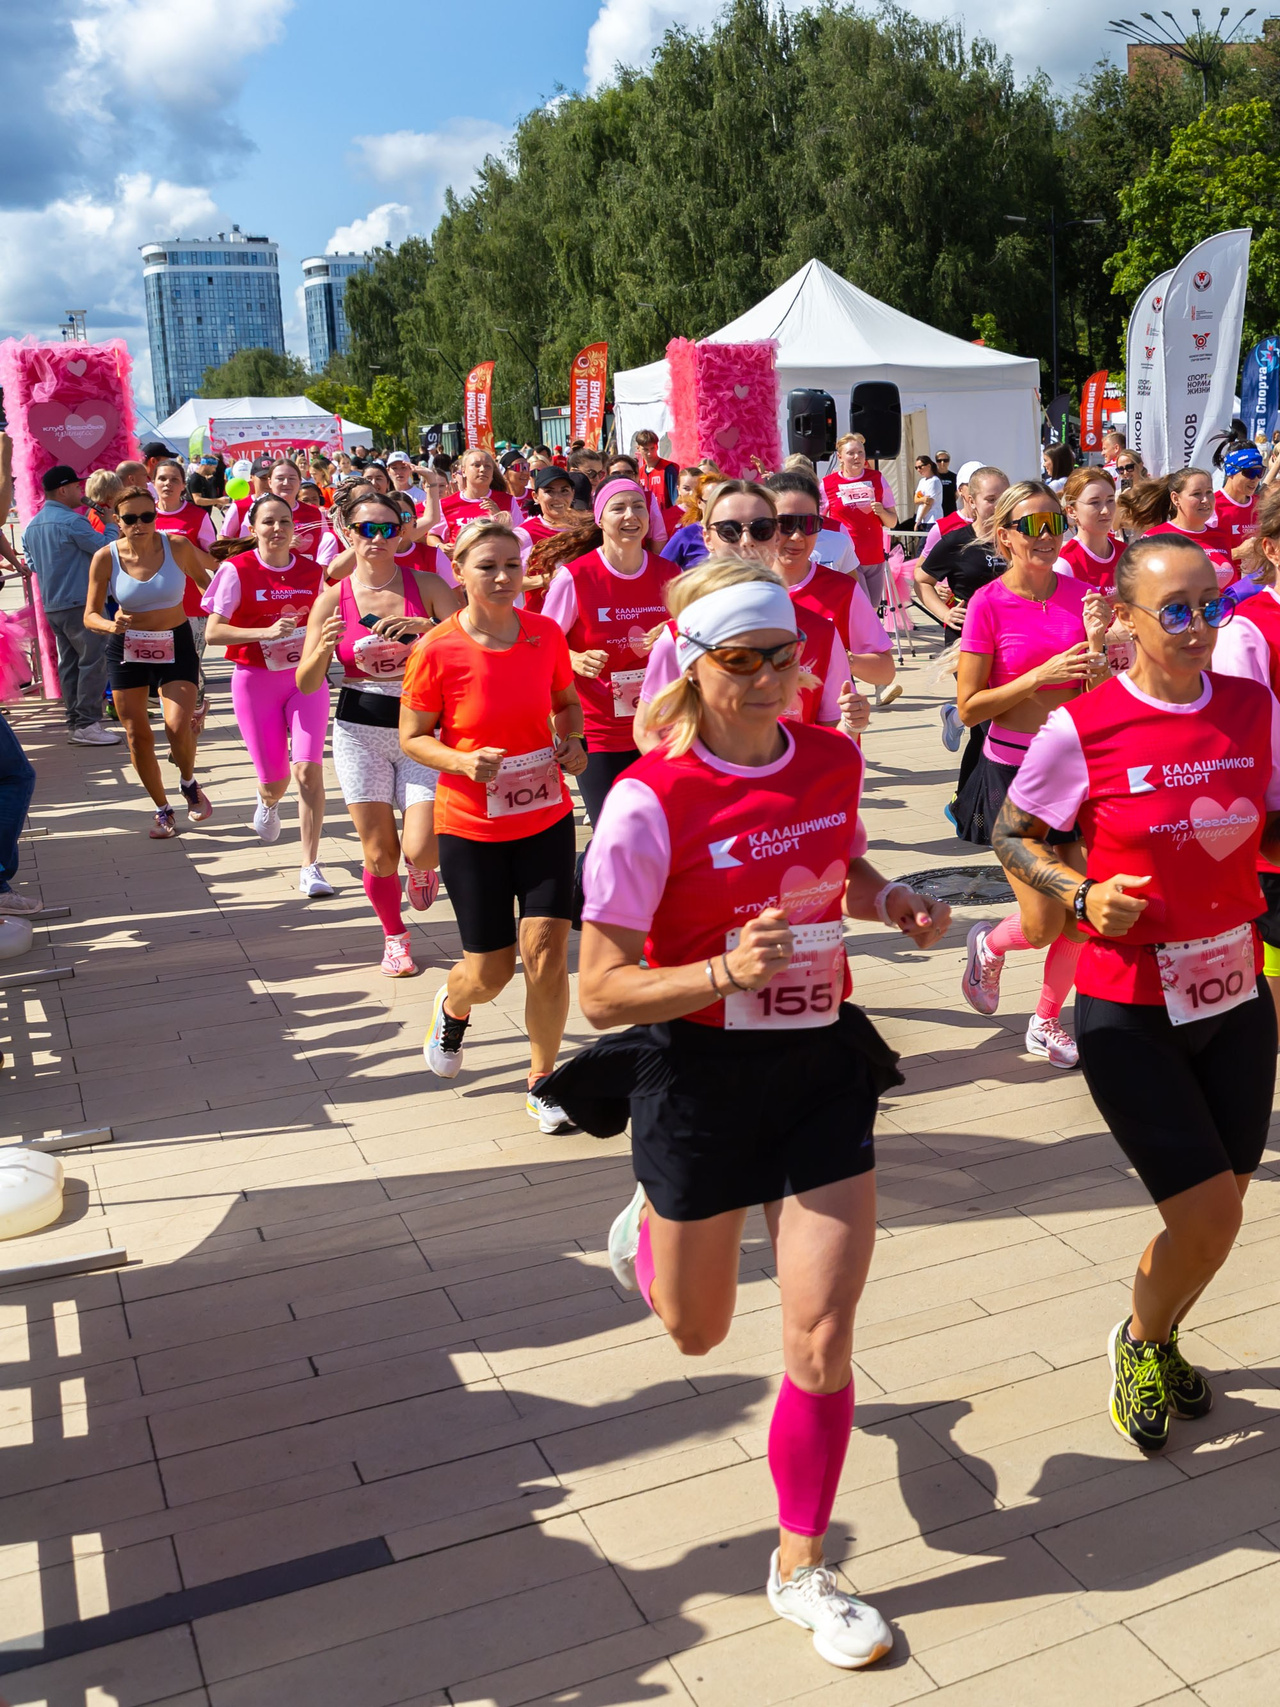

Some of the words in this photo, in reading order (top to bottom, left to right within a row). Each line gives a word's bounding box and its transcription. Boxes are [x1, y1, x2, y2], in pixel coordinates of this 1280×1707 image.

[615, 605, 667, 614] КАЛАШНИКОВ
[615, 613, 640, 621] СПОРТ
[133, 648, 166, 660] 130
[1162, 757, 1255, 777] КАЛАШНИКОВ
[1163, 771, 1211, 788] СПОРТ
[503, 783, 550, 809] 104
[748, 812, 848, 846] КАЛАШНИКОВ
[1149, 820, 1189, 834] клуб
[1192, 813, 1258, 830] беговых
[750, 837, 801, 861] СПОРТ
[757, 983, 833, 1017] 155
[1185, 970, 1243, 1009] 100
